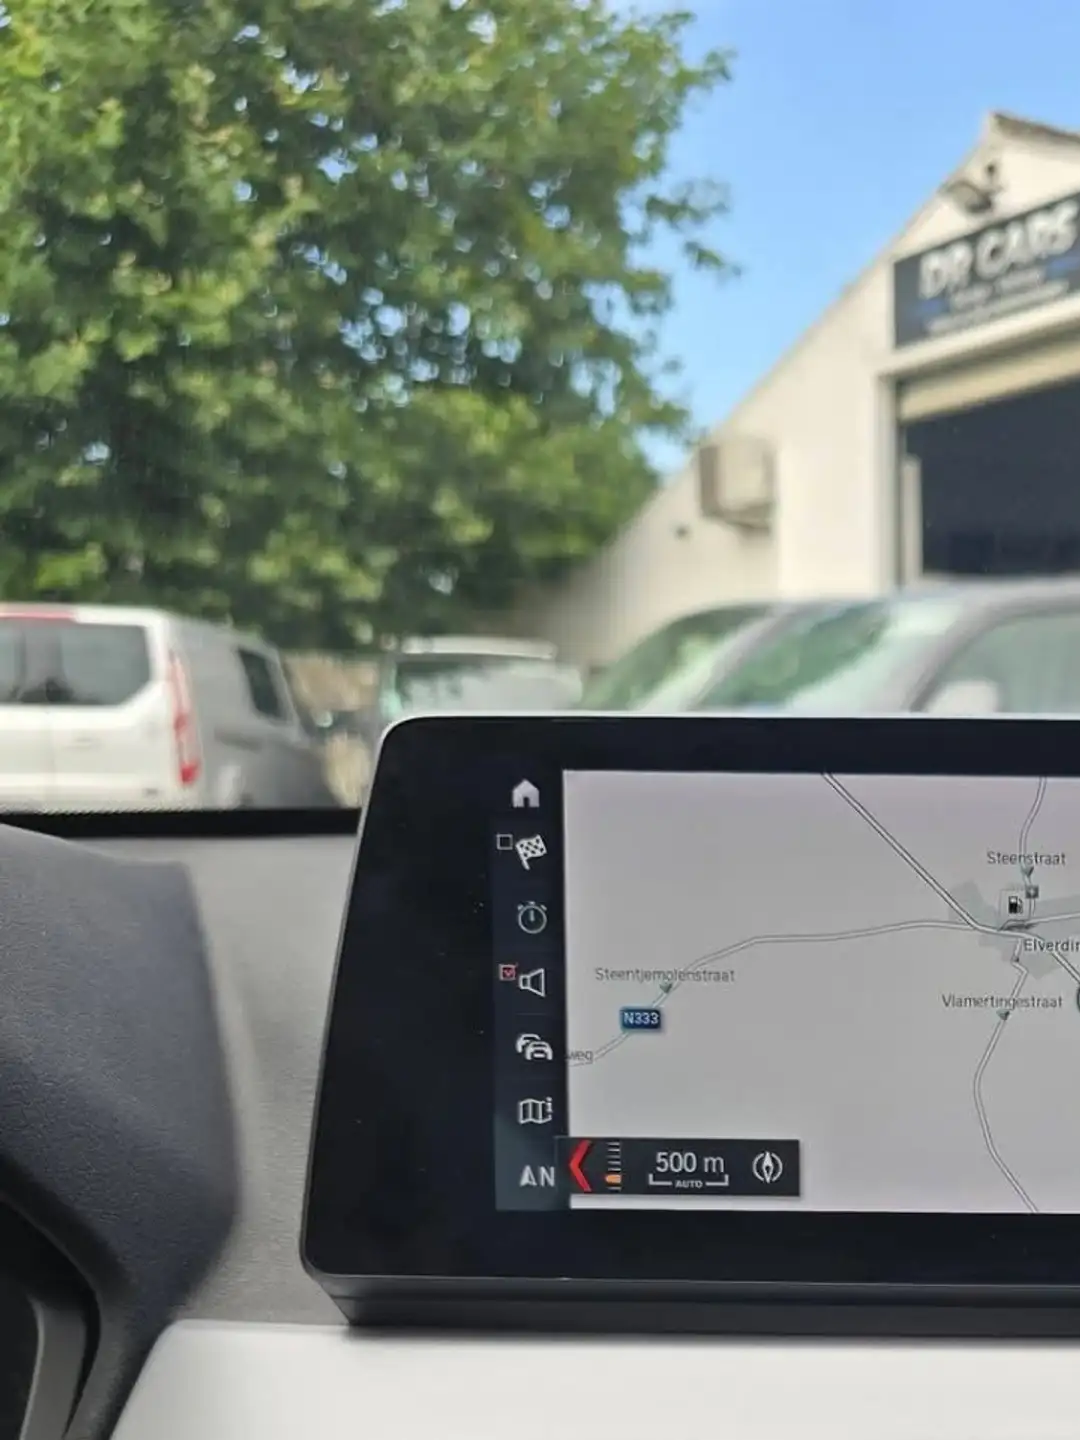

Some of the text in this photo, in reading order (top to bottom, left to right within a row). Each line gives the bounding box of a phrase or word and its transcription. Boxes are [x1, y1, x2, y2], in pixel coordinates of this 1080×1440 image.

[986, 851, 1066, 866] Steenstraat
[595, 967, 735, 983] Steentjemolenstraat
[942, 994, 1063, 1010] Vlamertingestraat
[623, 1012, 660, 1025] N333
[655, 1152, 725, 1173] 500 m
[675, 1180, 703, 1189] AUTO
